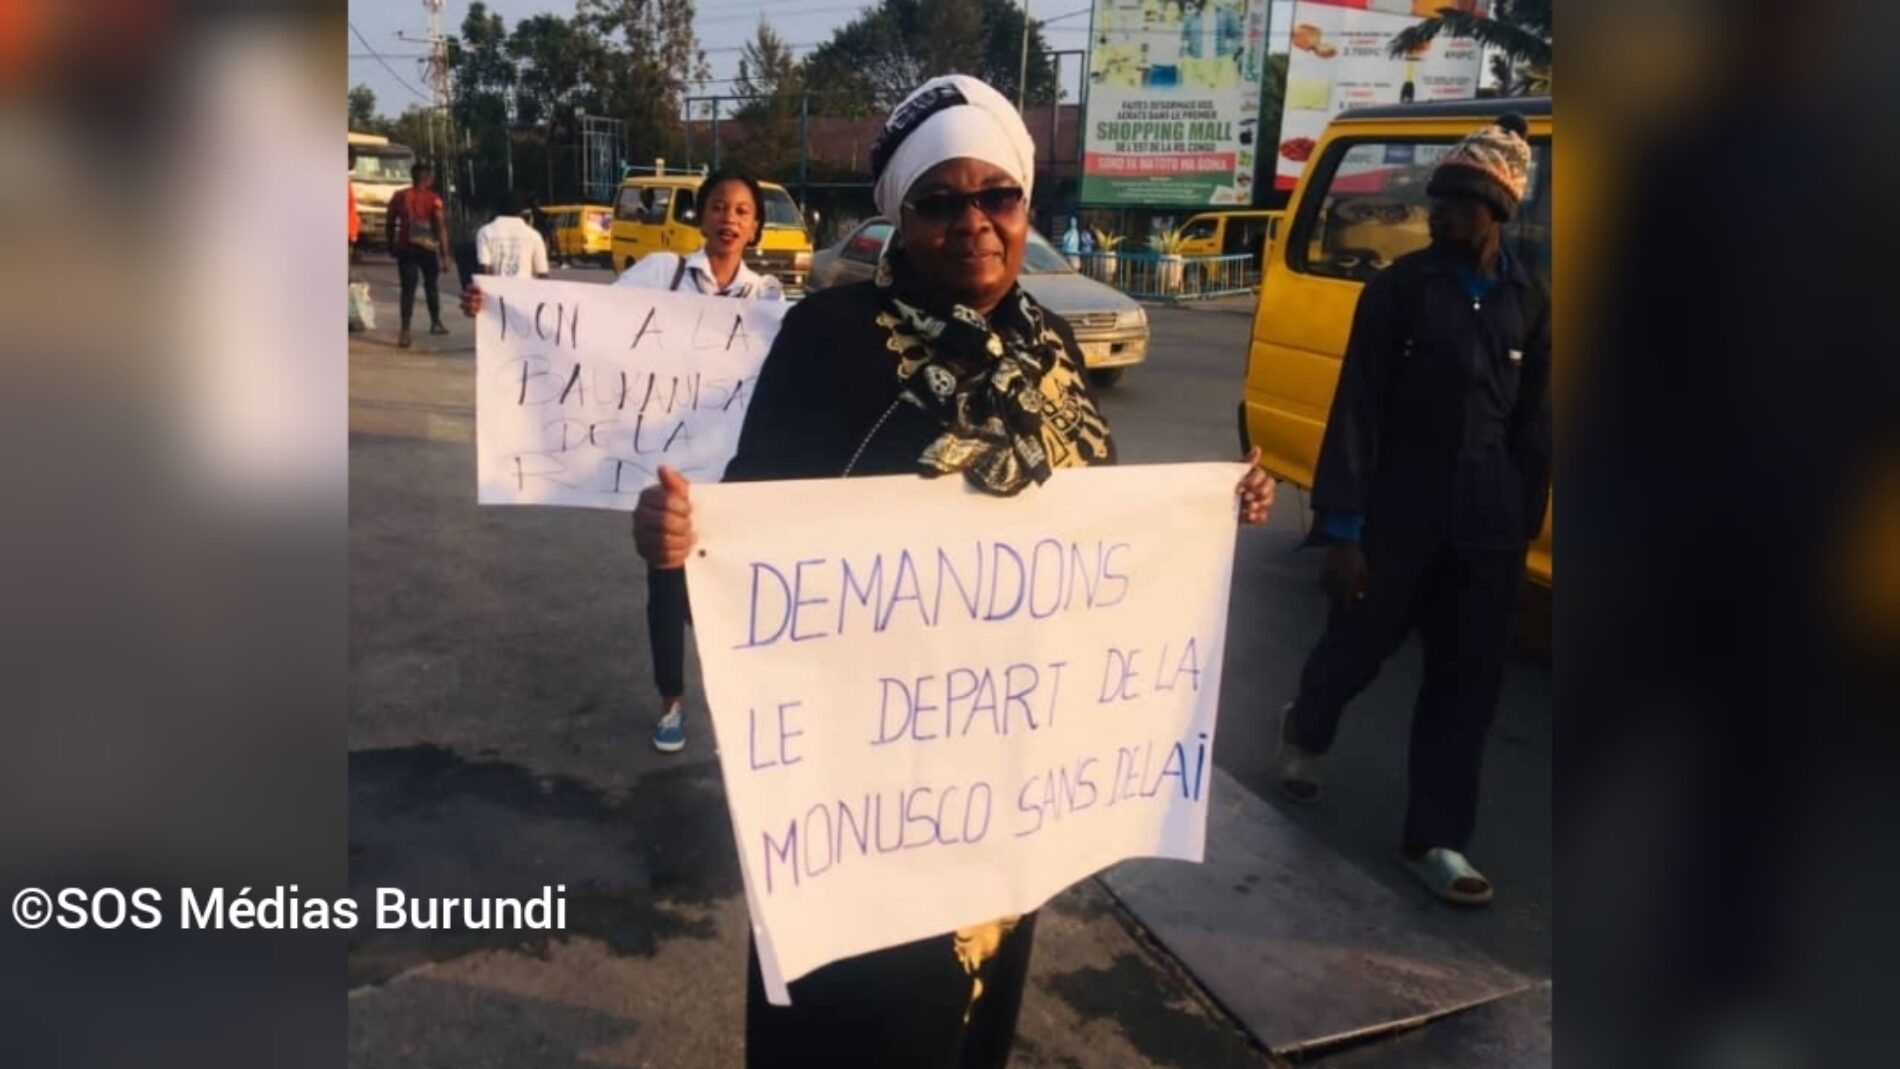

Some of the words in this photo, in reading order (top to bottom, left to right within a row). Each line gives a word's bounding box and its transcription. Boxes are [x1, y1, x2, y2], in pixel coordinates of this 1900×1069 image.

[1097, 121, 1185, 141] SHOPPING
[1188, 121, 1233, 141] MALL
[630, 306, 665, 350] A
[692, 312, 752, 351] LA
[500, 354, 757, 414] BALKANISA
[543, 418, 621, 453] DE
[633, 413, 697, 454] LA
[732, 538, 1132, 650] DEMANDONS
[748, 700, 804, 772] LE
[869, 660, 1069, 747] DEPART
[1098, 647, 1143, 704] DE
[1154, 636, 1201, 692] LA
[761, 781, 993, 896] MONUSCO
[1014, 756, 1099, 838] SANS
